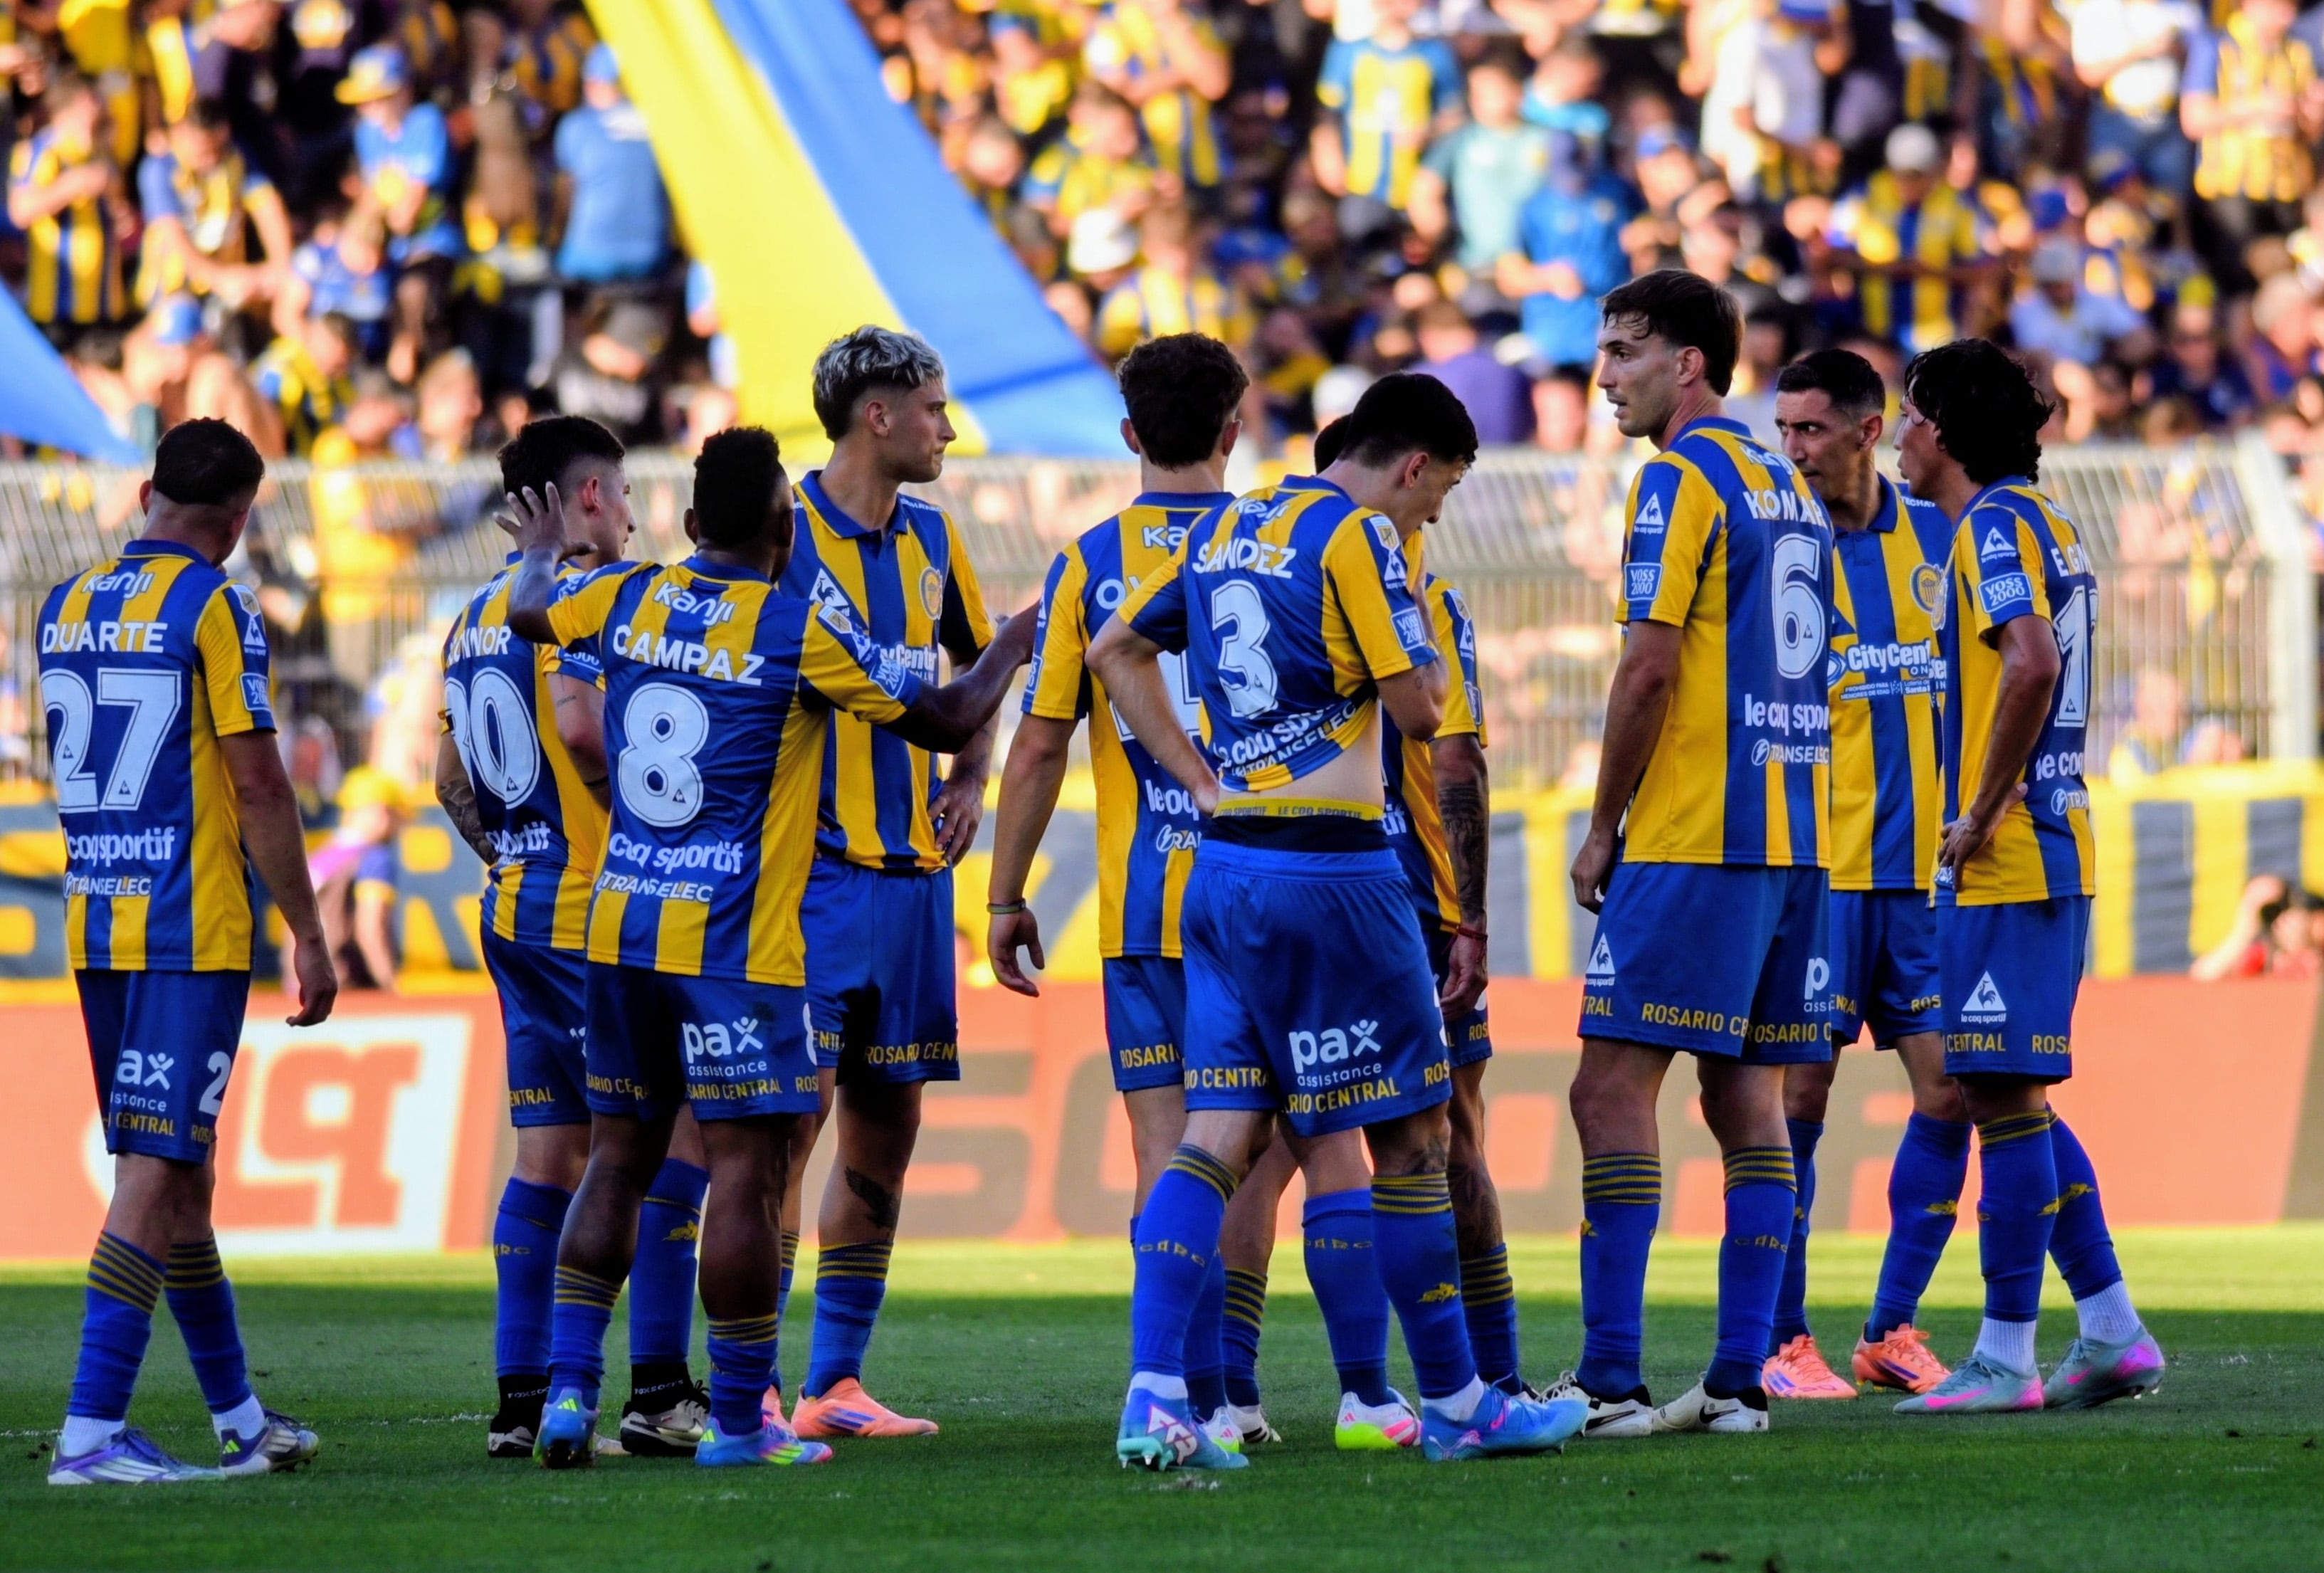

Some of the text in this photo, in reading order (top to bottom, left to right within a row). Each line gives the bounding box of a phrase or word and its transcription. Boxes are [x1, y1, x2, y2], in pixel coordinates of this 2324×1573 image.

[1631, 569, 1656, 582] VOSS
[1631, 582, 1653, 596] 2000
[1985, 577, 2023, 596] VOSS
[1772, 533, 1824, 679] 6
[1990, 586, 2026, 606] 2000
[41, 621, 168, 655] DUARTE
[1211, 579, 1279, 720] 3
[612, 624, 766, 686] CAMPAZ
[1745, 693, 1766, 727] le
[40, 667, 182, 814] 27
[618, 682, 710, 828] 8
[100, 826, 175, 868] sportif
[653, 840, 744, 875] sportif
[71, 875, 152, 896] TRANSELEC
[602, 870, 713, 903] TRANSELEC
[1641, 1003, 1724, 1032] ROSARIO
[682, 1016, 764, 1063] pax
[1288, 1019, 1382, 1074] pax
[1947, 1033, 2007, 1053] CENTRAL
[688, 1061, 767, 1077] assistance
[1298, 1063, 1382, 1088] assistance
[722, 1078, 783, 1100] CENTRAL
[1315, 1076, 1401, 1114] CENTRAL
[115, 1112, 175, 1137] CENTRAL
